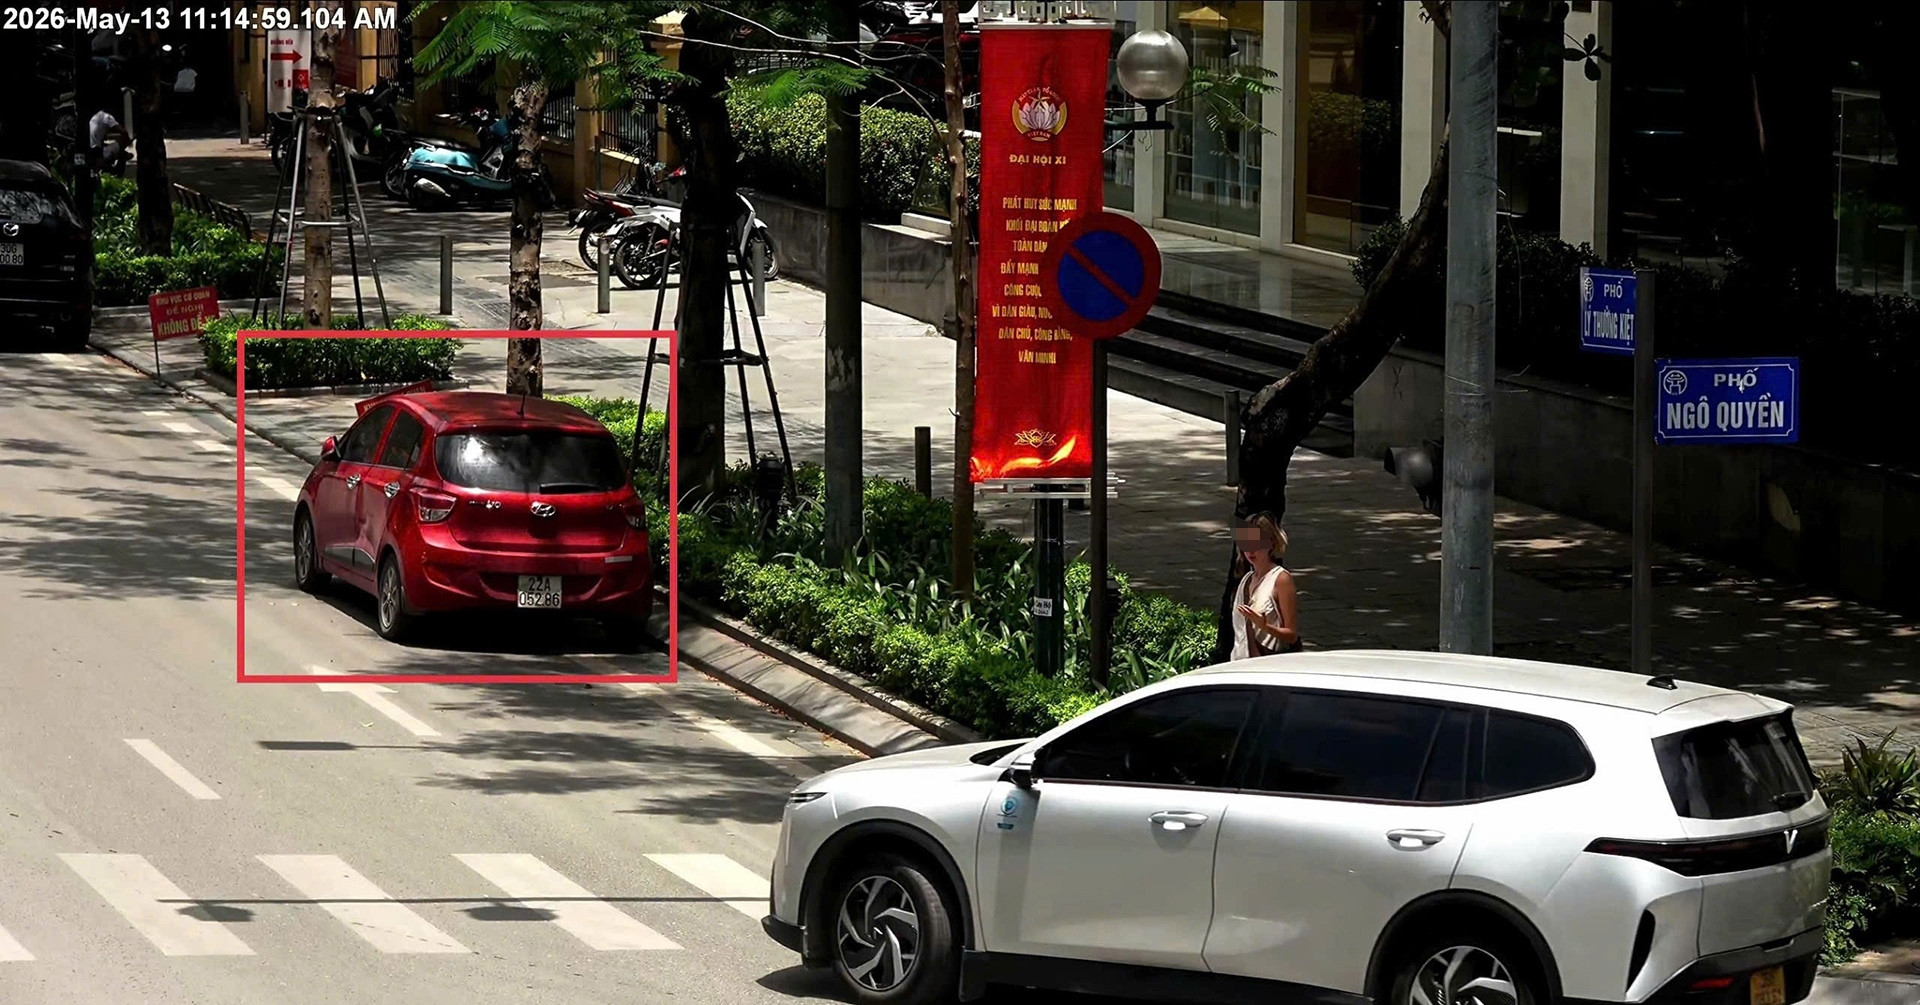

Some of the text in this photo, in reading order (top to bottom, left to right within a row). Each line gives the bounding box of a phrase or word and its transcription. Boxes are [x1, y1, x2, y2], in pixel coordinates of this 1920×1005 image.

[1009, 154, 1067, 166] ĐẠI HỘI XI
[1003, 195, 1077, 212] PHÁT HUY SỨC MẠNH
[1006, 216, 1023, 231] KHỐI
[1025, 219, 1038, 233] ĐẠI
[1038, 218, 1058, 233] ĐOÀN
[1012, 237, 1033, 252] TOÀN
[1017, 262, 1039, 276] MẠNH
[1004, 284, 1024, 296] CÔNG
[1604, 278, 1624, 299] PHỐ
[992, 303, 1000, 317] VÌ
[1001, 304, 1017, 318] DÂN
[1018, 303, 1037, 319] GIÀU,
[157, 318, 189, 336] KHÔNG
[1584, 304, 1635, 345] LÝ THƯỜNG KIỆT
[999, 326, 1014, 339] DÂN
[1016, 325, 1033, 341] CHỦ,
[1034, 326, 1053, 341] CÔNG
[1018, 349, 1034, 363] VĂN
[1714, 367, 1759, 387] PHỐ
[1666, 392, 1785, 432] NGÔ QUYỀN
[528, 577, 551, 592] 22A
[519, 591, 560, 607] 052.86
